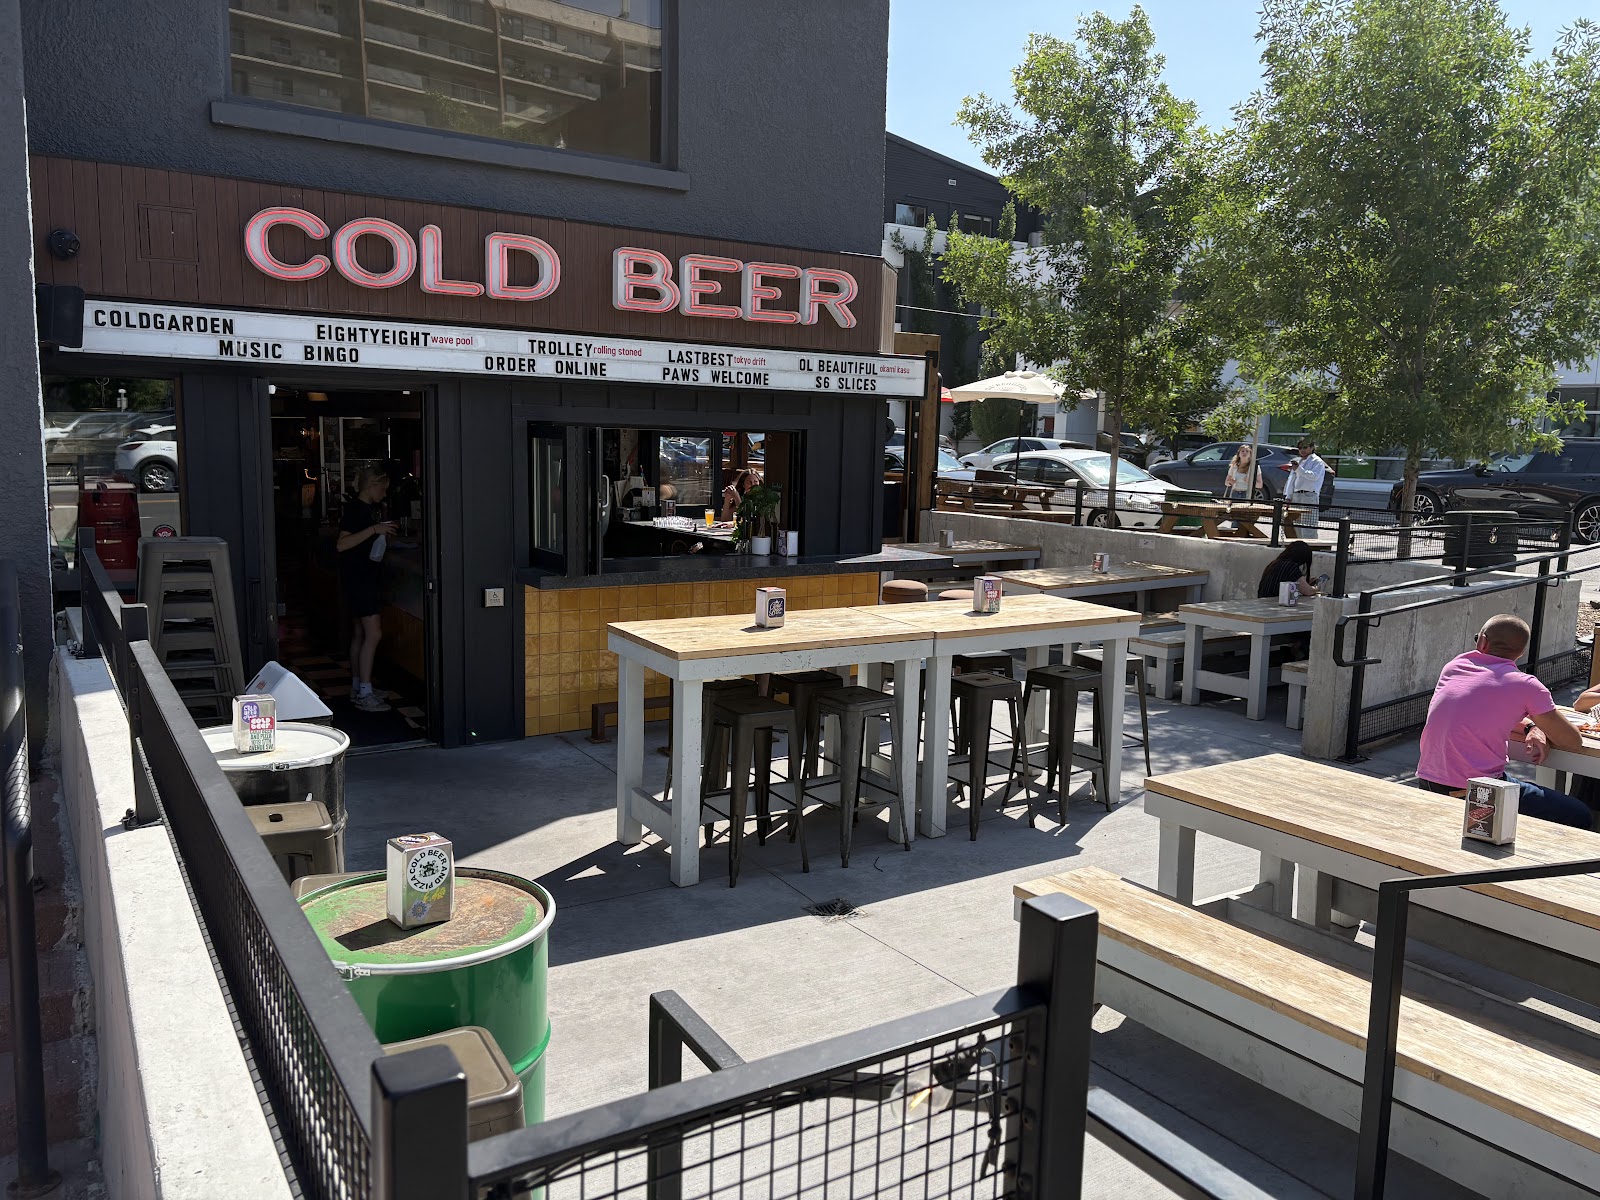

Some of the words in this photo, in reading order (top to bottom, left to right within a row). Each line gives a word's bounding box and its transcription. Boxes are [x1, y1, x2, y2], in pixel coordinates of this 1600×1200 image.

[244, 206, 561, 302] COLD
[612, 246, 859, 329] BEER
[94, 309, 235, 335] COLDGARDEN
[316, 324, 431, 347] EIGHTYEIGHT
[431, 336, 453, 345] wave
[456, 336, 473, 347] pool
[218, 340, 283, 359] MUSIC
[303, 345, 359, 363] BINGO
[528, 339, 593, 357] TROLLEY
[593, 344, 616, 357] rolling
[617, 346, 642, 357] stoned
[484, 356, 536, 373] ORDER
[555, 360, 607, 377] ONLINE
[668, 349, 734, 367] LASTBEST
[734, 356, 751, 366] tokyo
[752, 357, 766, 366] drift
[799, 358, 813, 372] OL
[818, 359, 878, 375] BEAUTIFUL
[662, 367, 700, 382] PAWS
[711, 370, 769, 386] WELCOME
[838, 377, 877, 391] SLICES
[410, 852, 426, 873] COLD
[427, 849, 448, 865] BEER
[411, 876, 433, 889] PIZZA
[435, 866, 447, 884] AND
